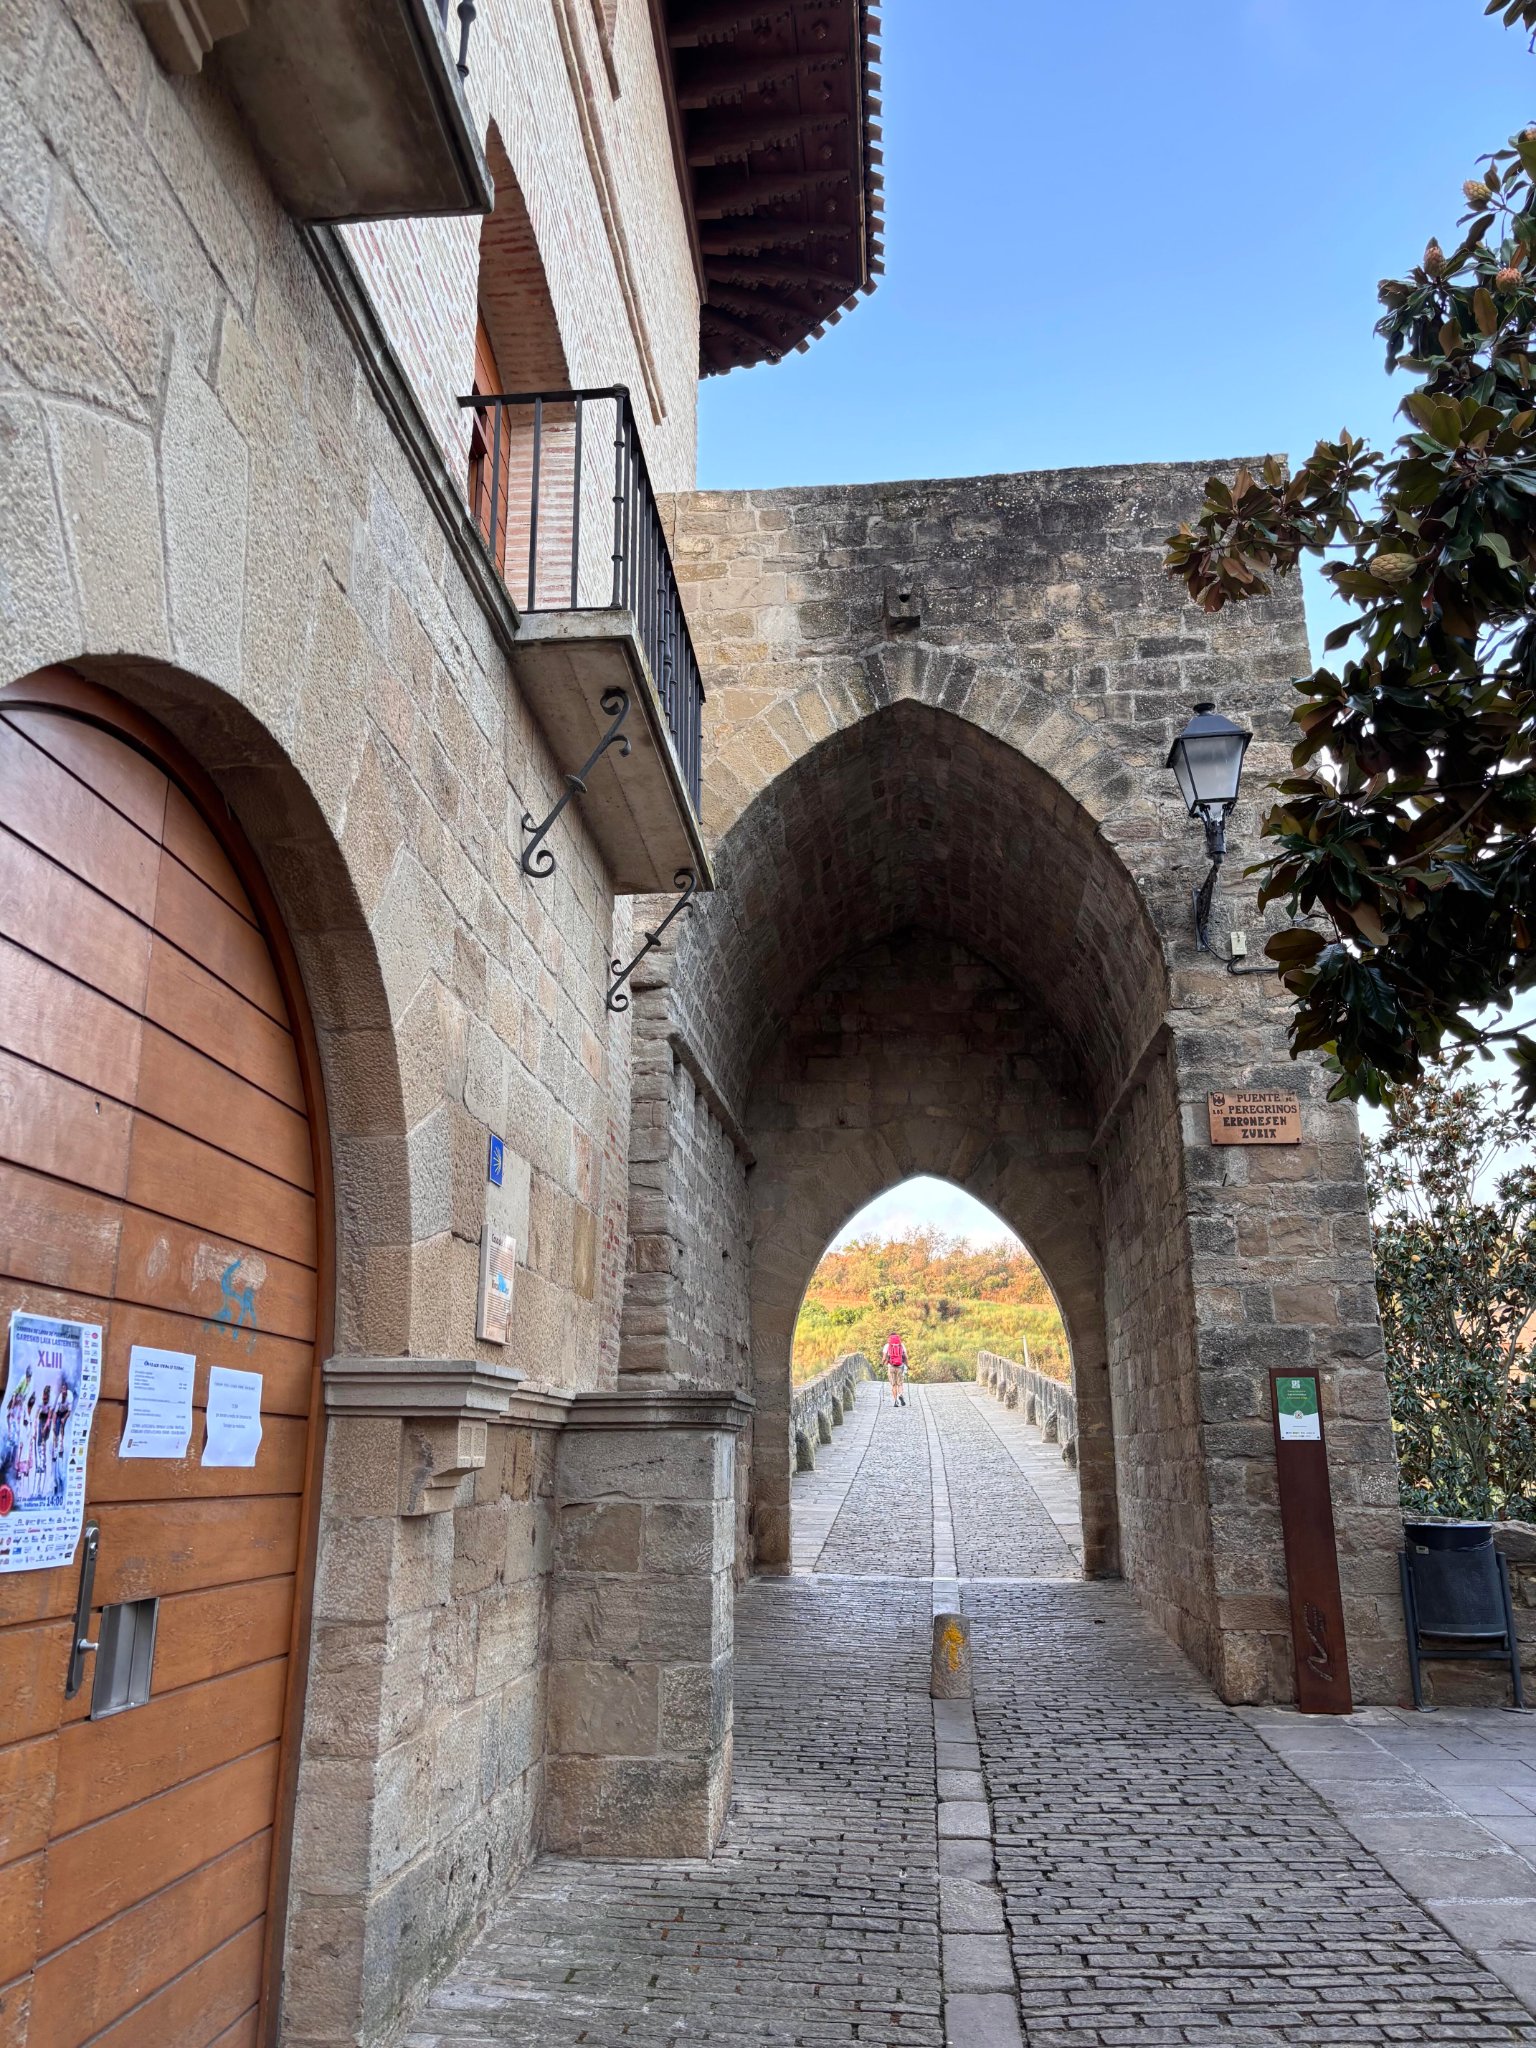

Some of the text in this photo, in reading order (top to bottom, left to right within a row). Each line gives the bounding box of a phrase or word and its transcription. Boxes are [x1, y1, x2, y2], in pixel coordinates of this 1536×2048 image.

[1237, 1093, 1281, 1103] PUENTE
[1228, 1104, 1298, 1115] PEREGRINOS
[1241, 1128, 1277, 1139] ZUBIA
[37, 1350, 62, 1370] XLIII
[46, 1495, 63, 1506] 14:00
